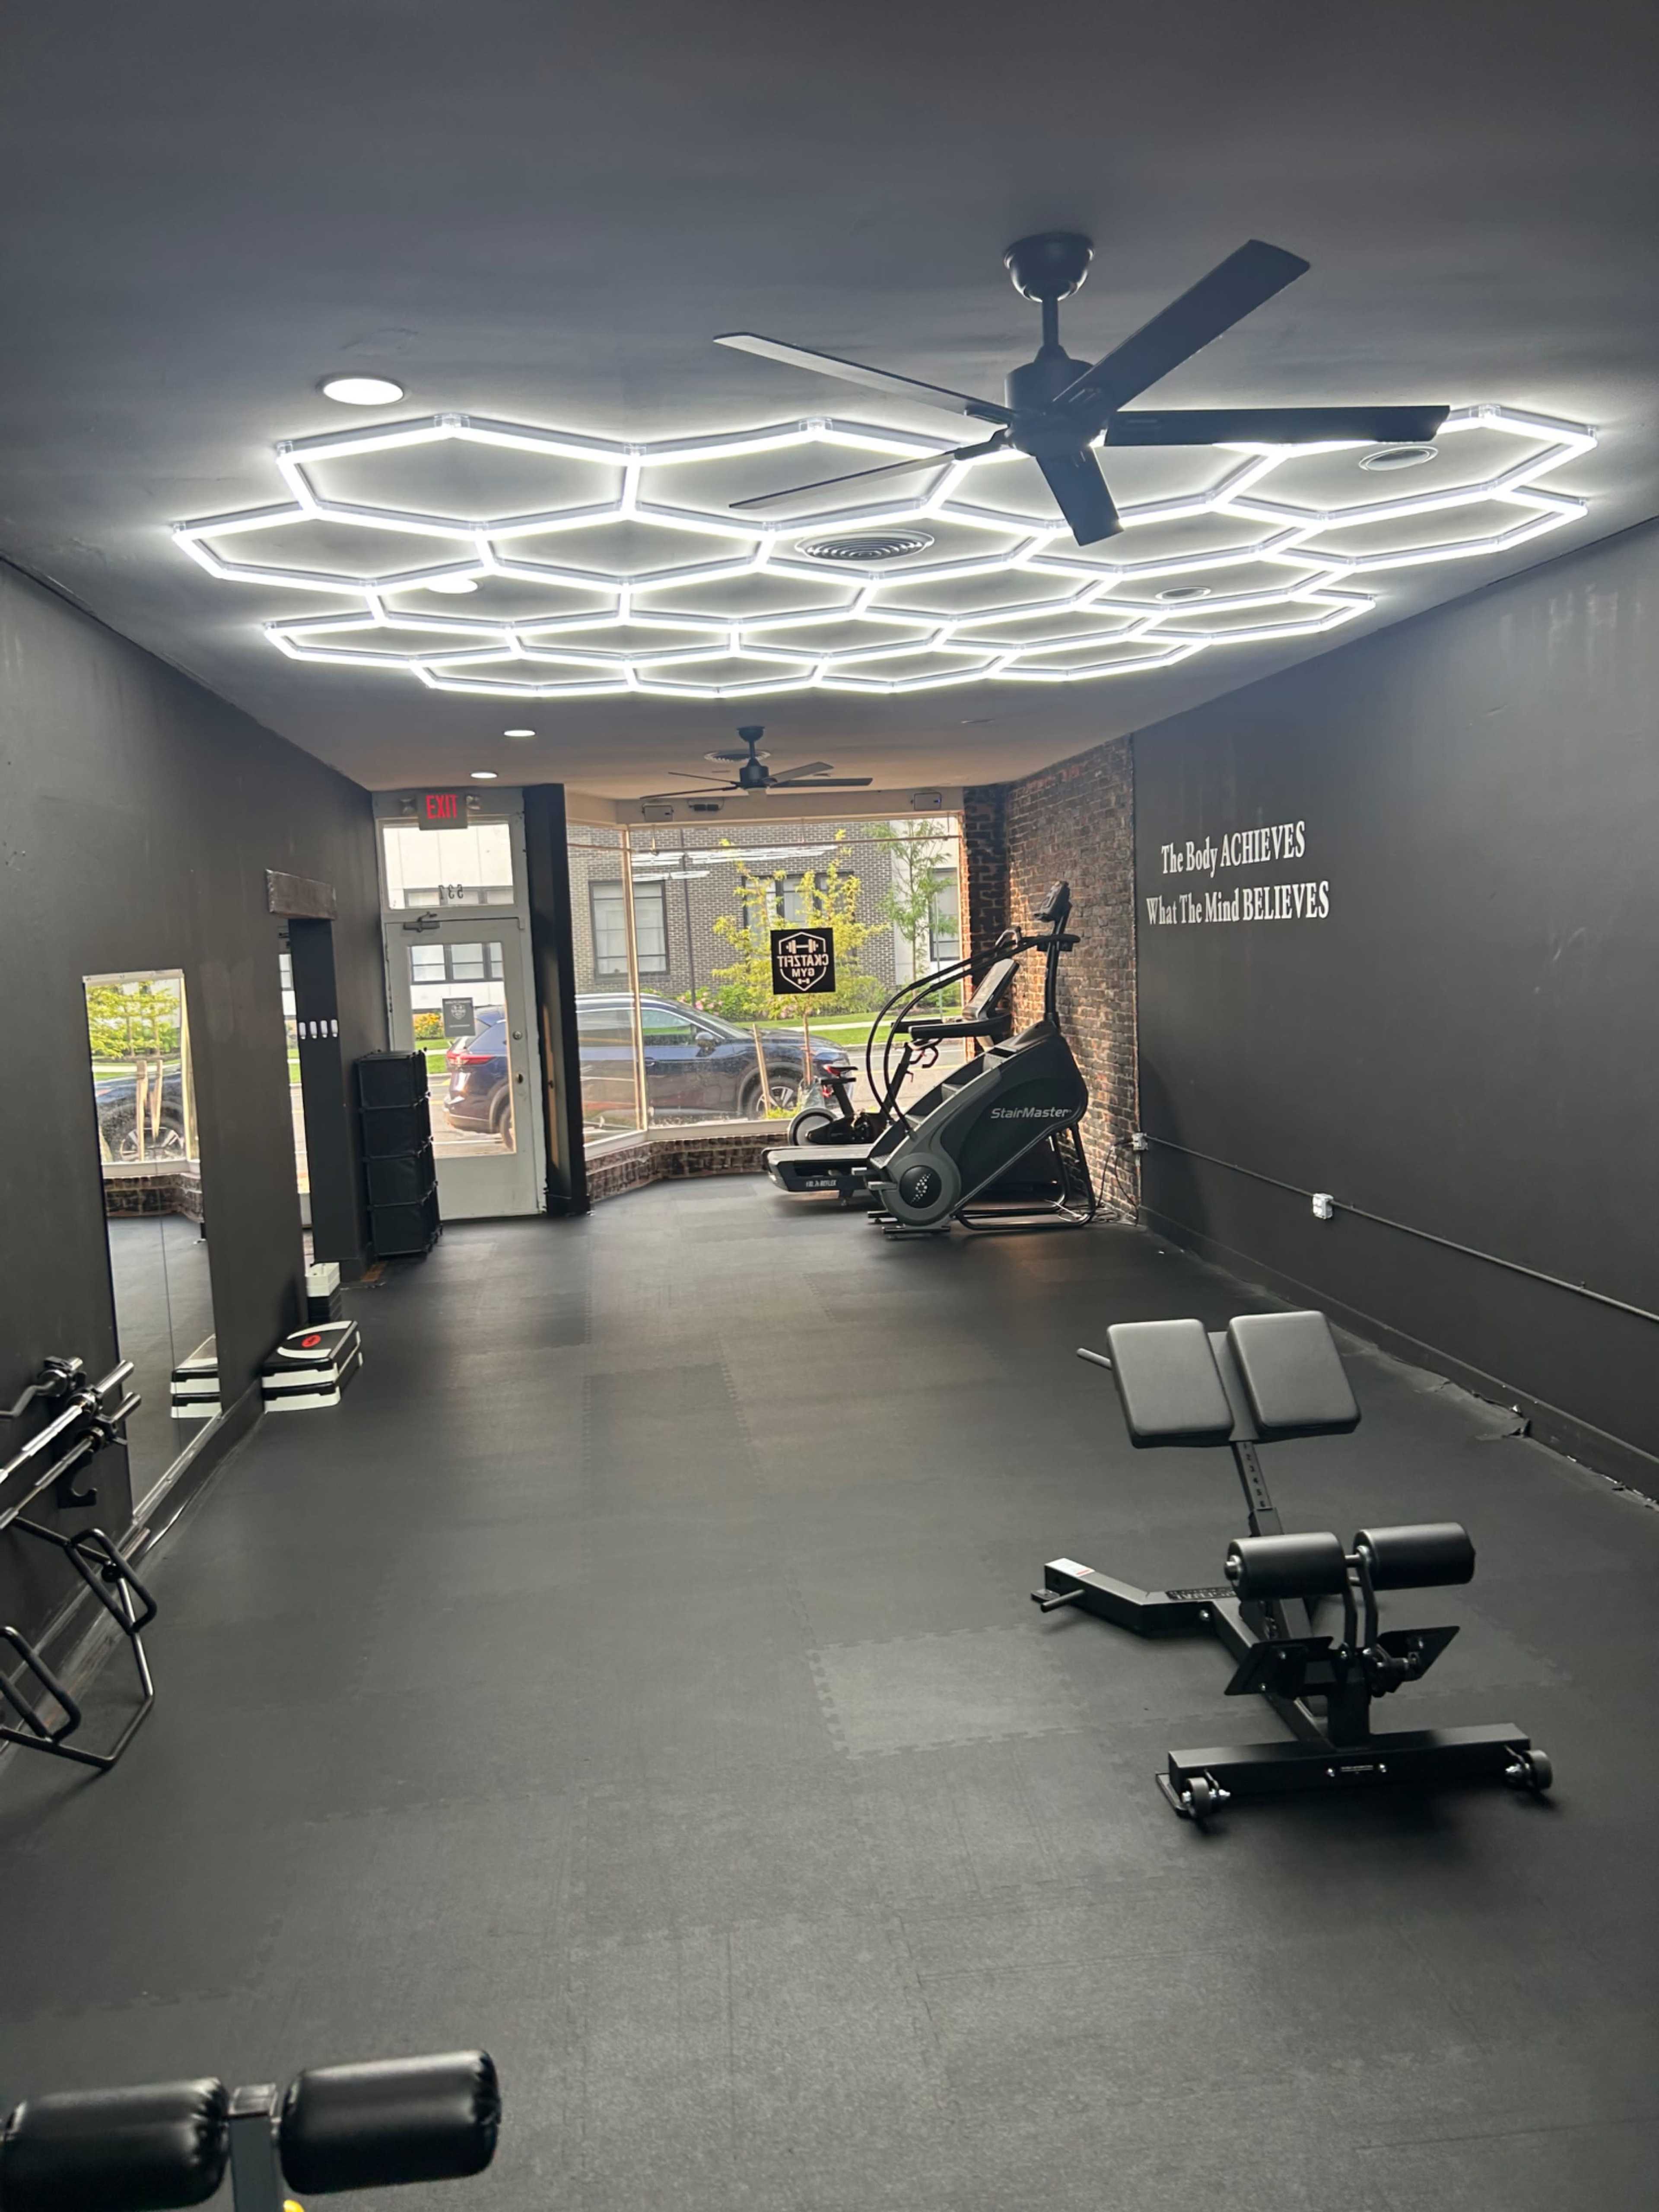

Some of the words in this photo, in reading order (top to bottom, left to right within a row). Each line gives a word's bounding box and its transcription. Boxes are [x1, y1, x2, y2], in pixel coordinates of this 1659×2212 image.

[426, 794, 458, 819] EXIT
[1161, 843, 1183, 874] The
[1185, 836, 1218, 878] Body
[1220, 820, 1305, 867] ACHIEVES
[1146, 896, 1177, 925] What
[1179, 892, 1202, 924] The
[1205, 887, 1239, 922] Mind
[1243, 880, 1330, 921] BELIEVES
[990, 1107, 1068, 1119] StairMaster
